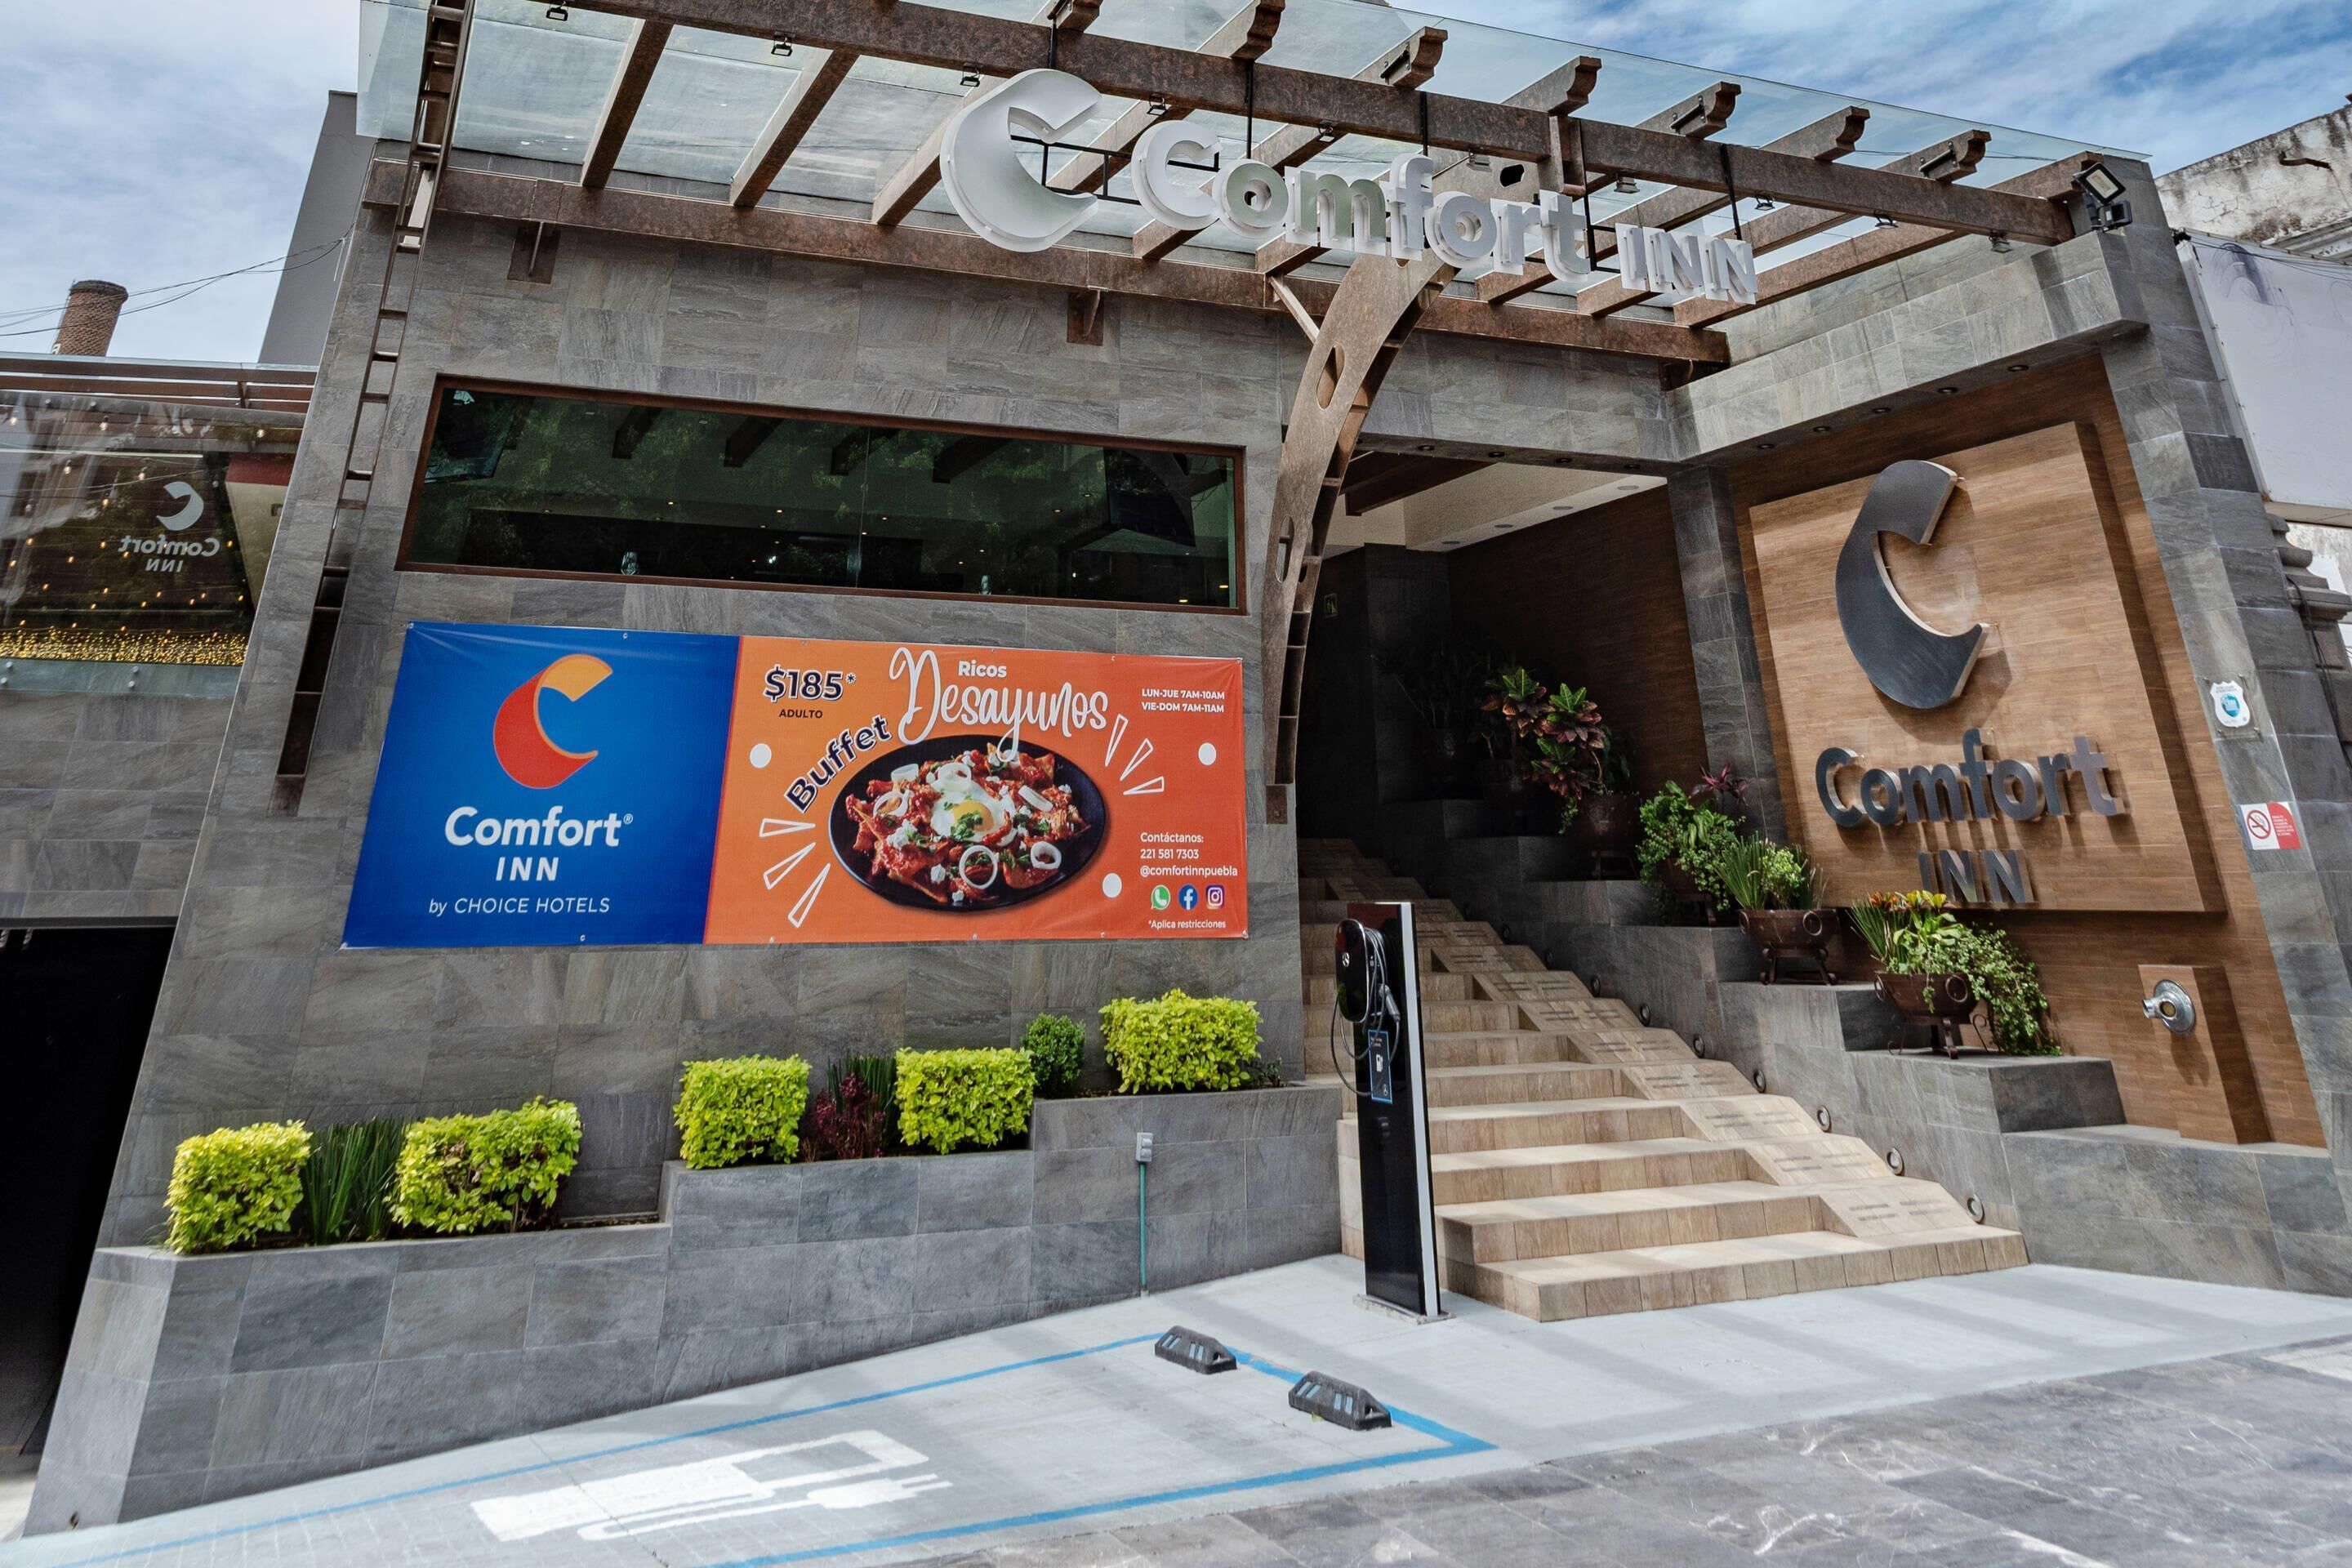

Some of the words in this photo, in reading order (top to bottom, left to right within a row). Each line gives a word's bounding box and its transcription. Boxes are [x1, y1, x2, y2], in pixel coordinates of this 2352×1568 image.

[1131, 120, 1591, 283] Comfort
[1615, 222, 1757, 305] INN
[958, 660, 1007, 678] Ricos
[778, 708, 823, 719] ADULTO
[889, 647, 1108, 762] Desayunos
[783, 714, 893, 814] Buffet
[1815, 728, 2126, 827] Comfort
[1140, 831, 1205, 844] Contáctanos:
[1140, 849, 1156, 859] 221
[1158, 849, 1174, 859] 581
[1176, 849, 1200, 860] 7303
[495, 856, 559, 881] INN
[1140, 865, 1239, 879] @comfortinnpuebla
[1918, 849, 2039, 906] INN
[428, 898, 448, 918] by
[454, 897, 530, 914] CHOICE
[536, 897, 611, 914] HOTELS
[1177, 920, 1226, 929] restricciones
